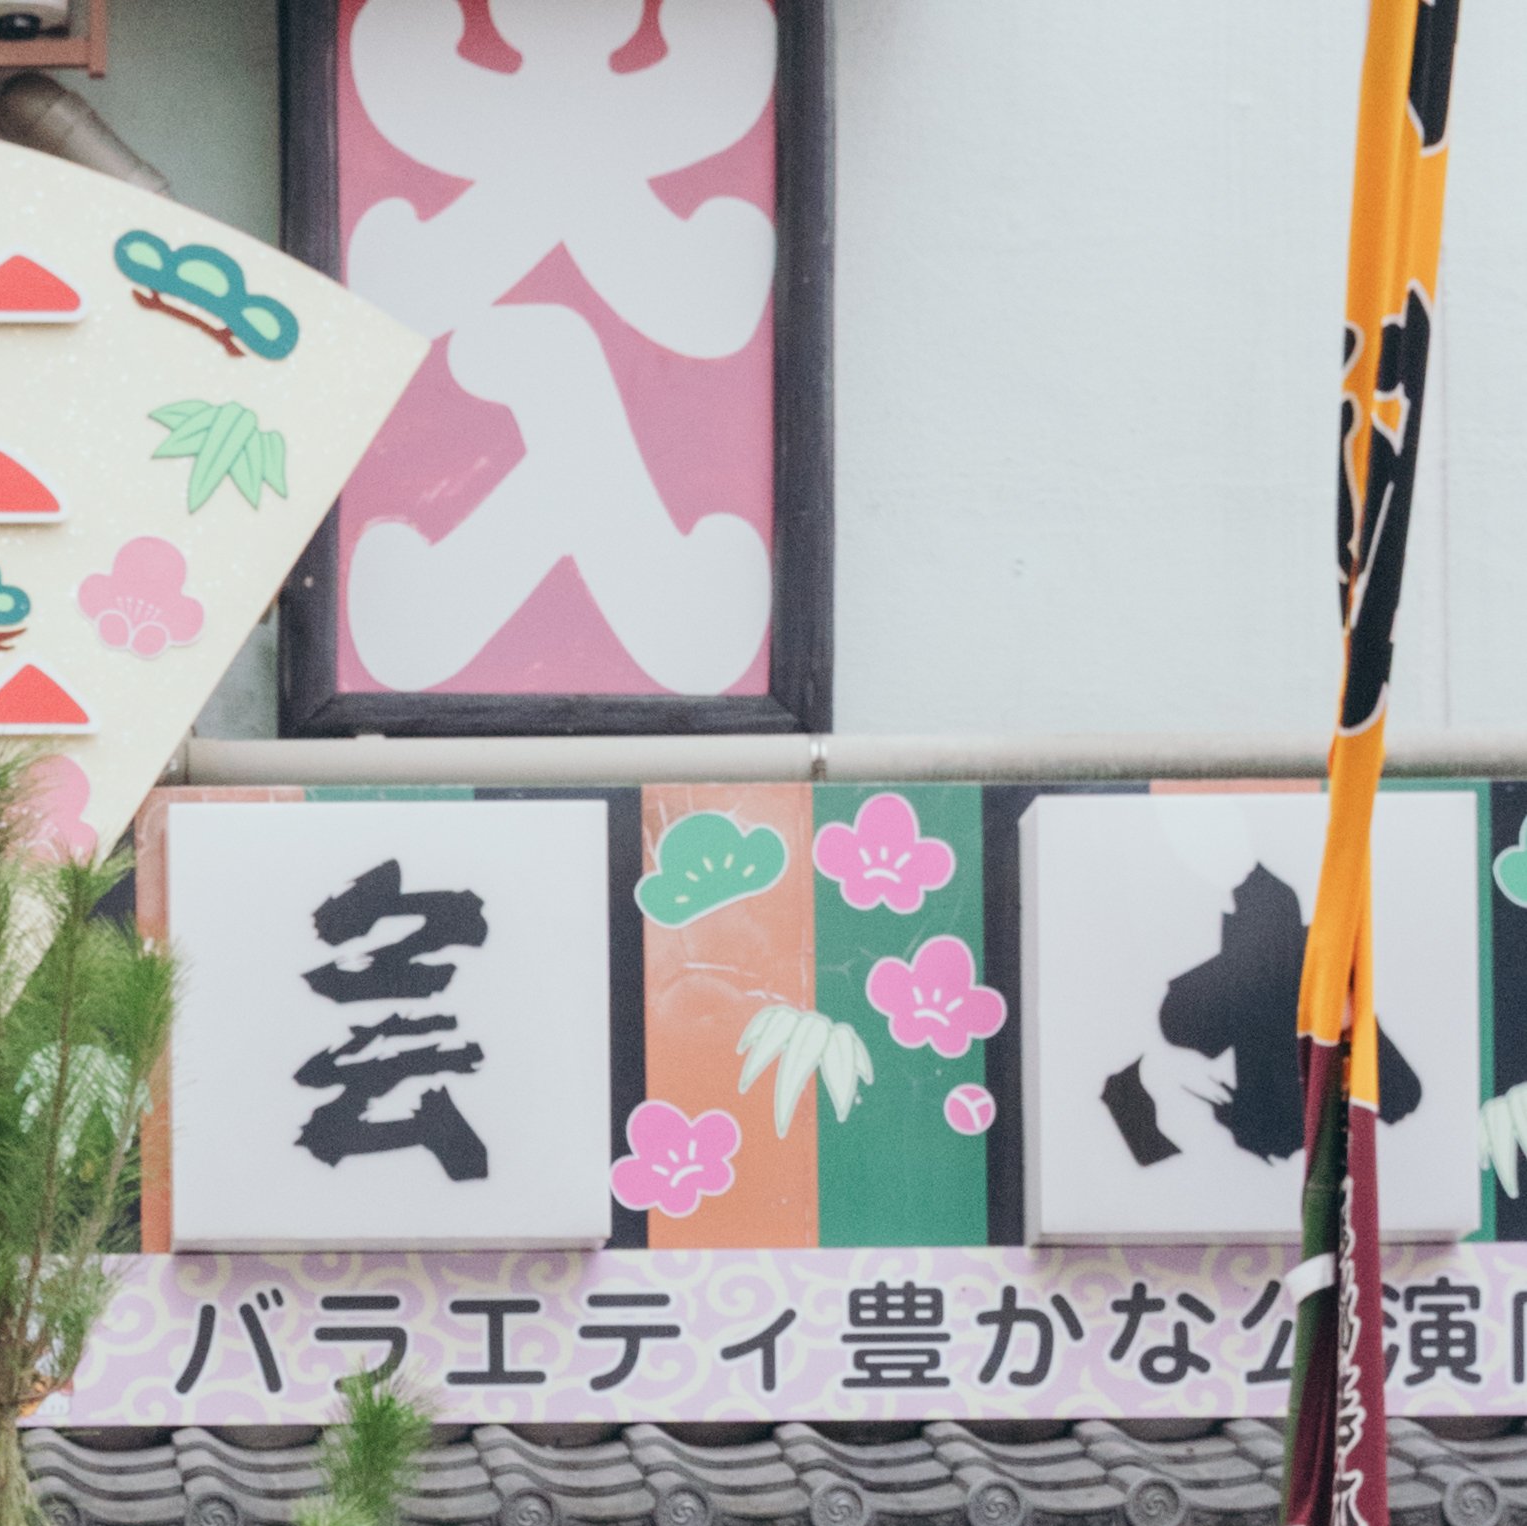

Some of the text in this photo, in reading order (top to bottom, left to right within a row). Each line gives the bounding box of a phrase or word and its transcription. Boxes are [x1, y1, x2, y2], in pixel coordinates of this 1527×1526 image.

[293, 859, 488, 1181] 芸
[174, 1277, 1527, 1394] バラエティ豊かな演
